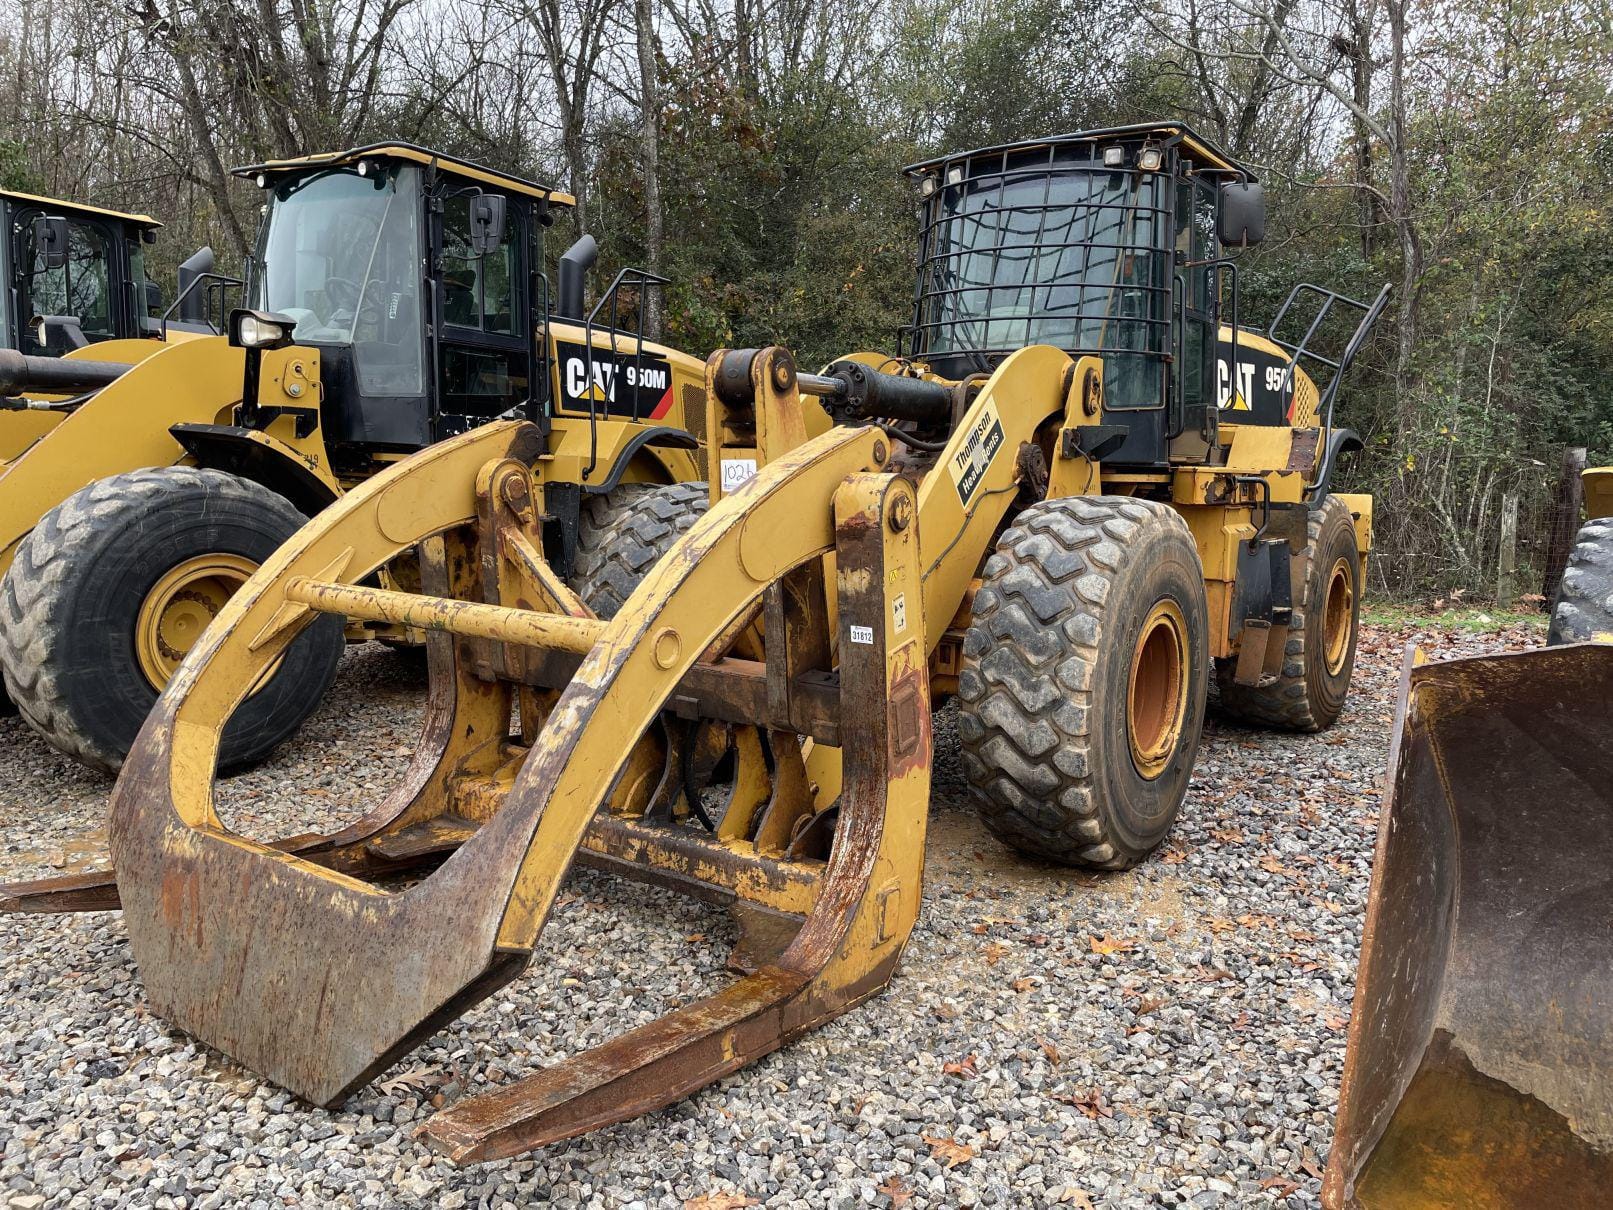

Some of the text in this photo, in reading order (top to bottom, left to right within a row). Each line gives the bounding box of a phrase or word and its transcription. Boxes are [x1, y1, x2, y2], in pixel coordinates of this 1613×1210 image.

[566, 357, 666, 402] CAT 950M
[1217, 359, 1256, 411] CAT
[955, 411, 991, 469] Thompson
[962, 432, 1000, 495] Heavy Rents
[852, 630, 872, 642] 31812
